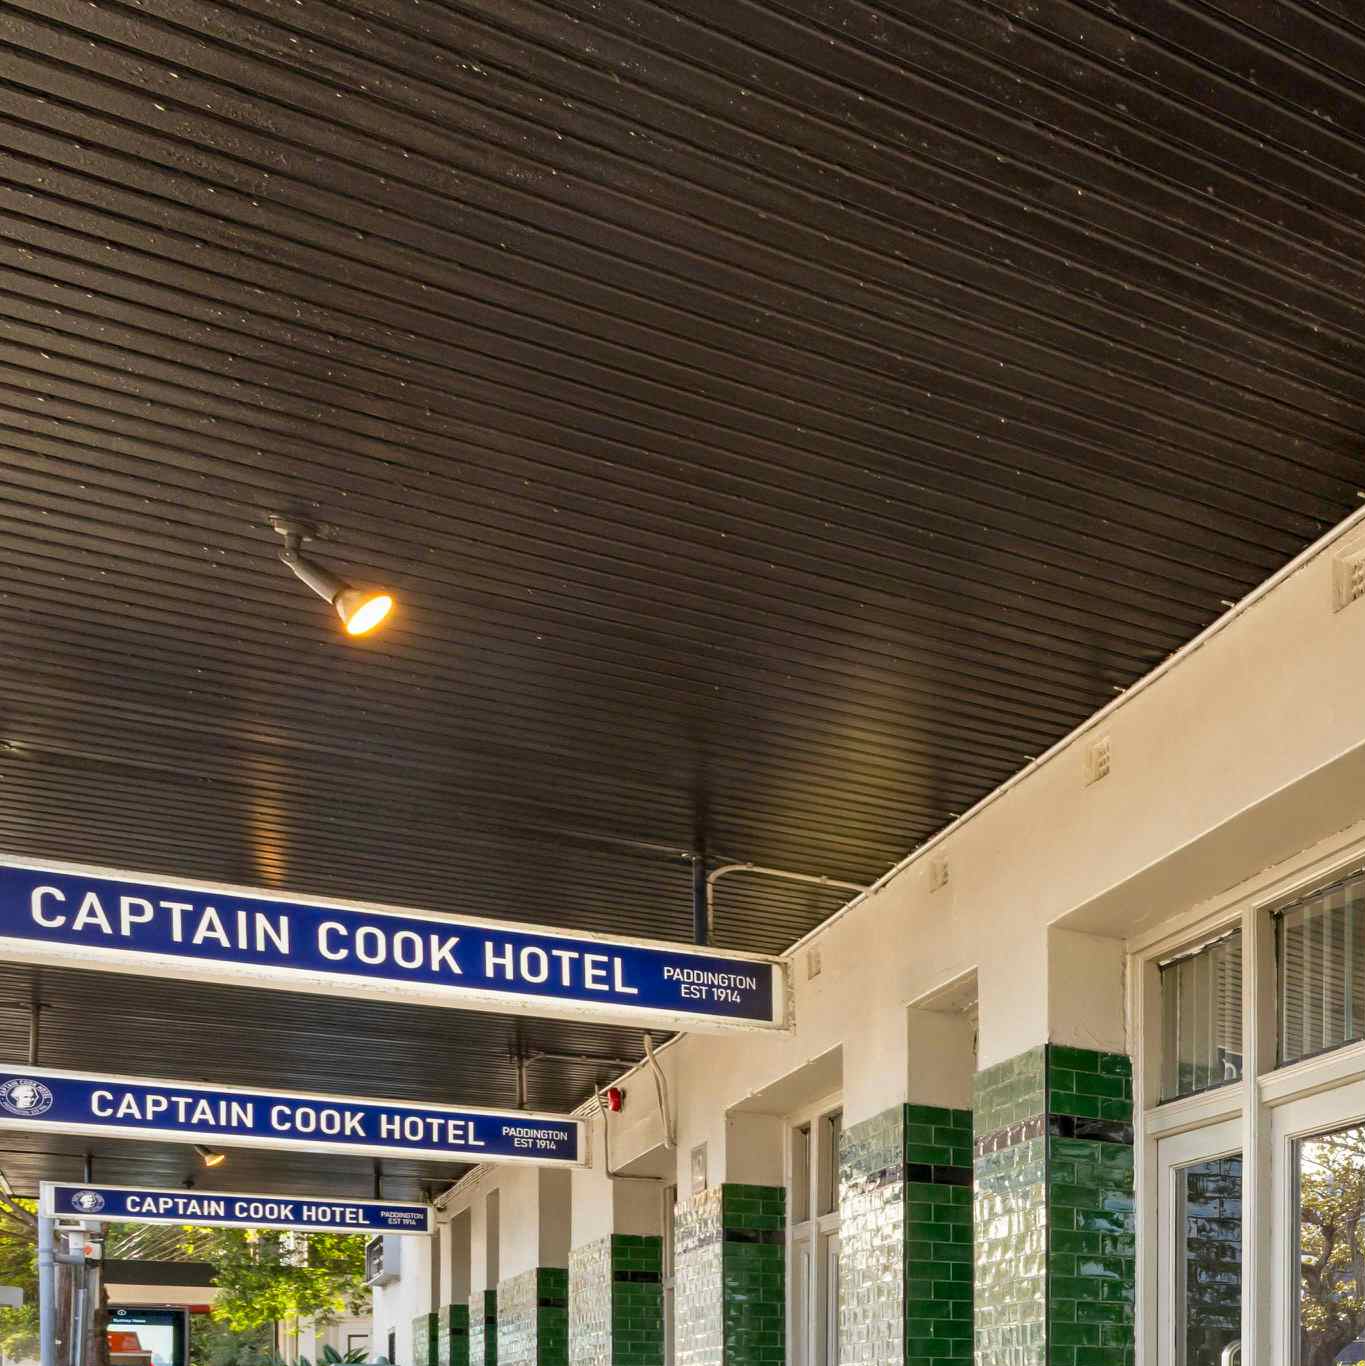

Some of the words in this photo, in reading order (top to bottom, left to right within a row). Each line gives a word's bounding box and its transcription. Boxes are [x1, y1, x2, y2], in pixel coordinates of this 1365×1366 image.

[30, 886, 290, 954] CAPTAIN
[317, 921, 464, 975] COOK
[485, 941, 638, 994] HOTEL
[663, 966, 757, 990] PADDINGTON
[680, 984, 708, 1001] EST
[712, 987, 741, 1004] 1914
[91, 1090, 254, 1128] CAPTAIN
[271, 1105, 367, 1137] COOK
[380, 1113, 485, 1146] HOTEL
[502, 1126, 568, 1141] PADDINGTON
[514, 1137, 533, 1148] EST
[536, 1139, 556, 1150] 1914
[126, 1196, 225, 1217] CAPTAIN
[234, 1202, 294, 1221] COOK
[302, 1205, 371, 1224] HOTEL
[380, 1211, 424, 1220] PADDINGTON
